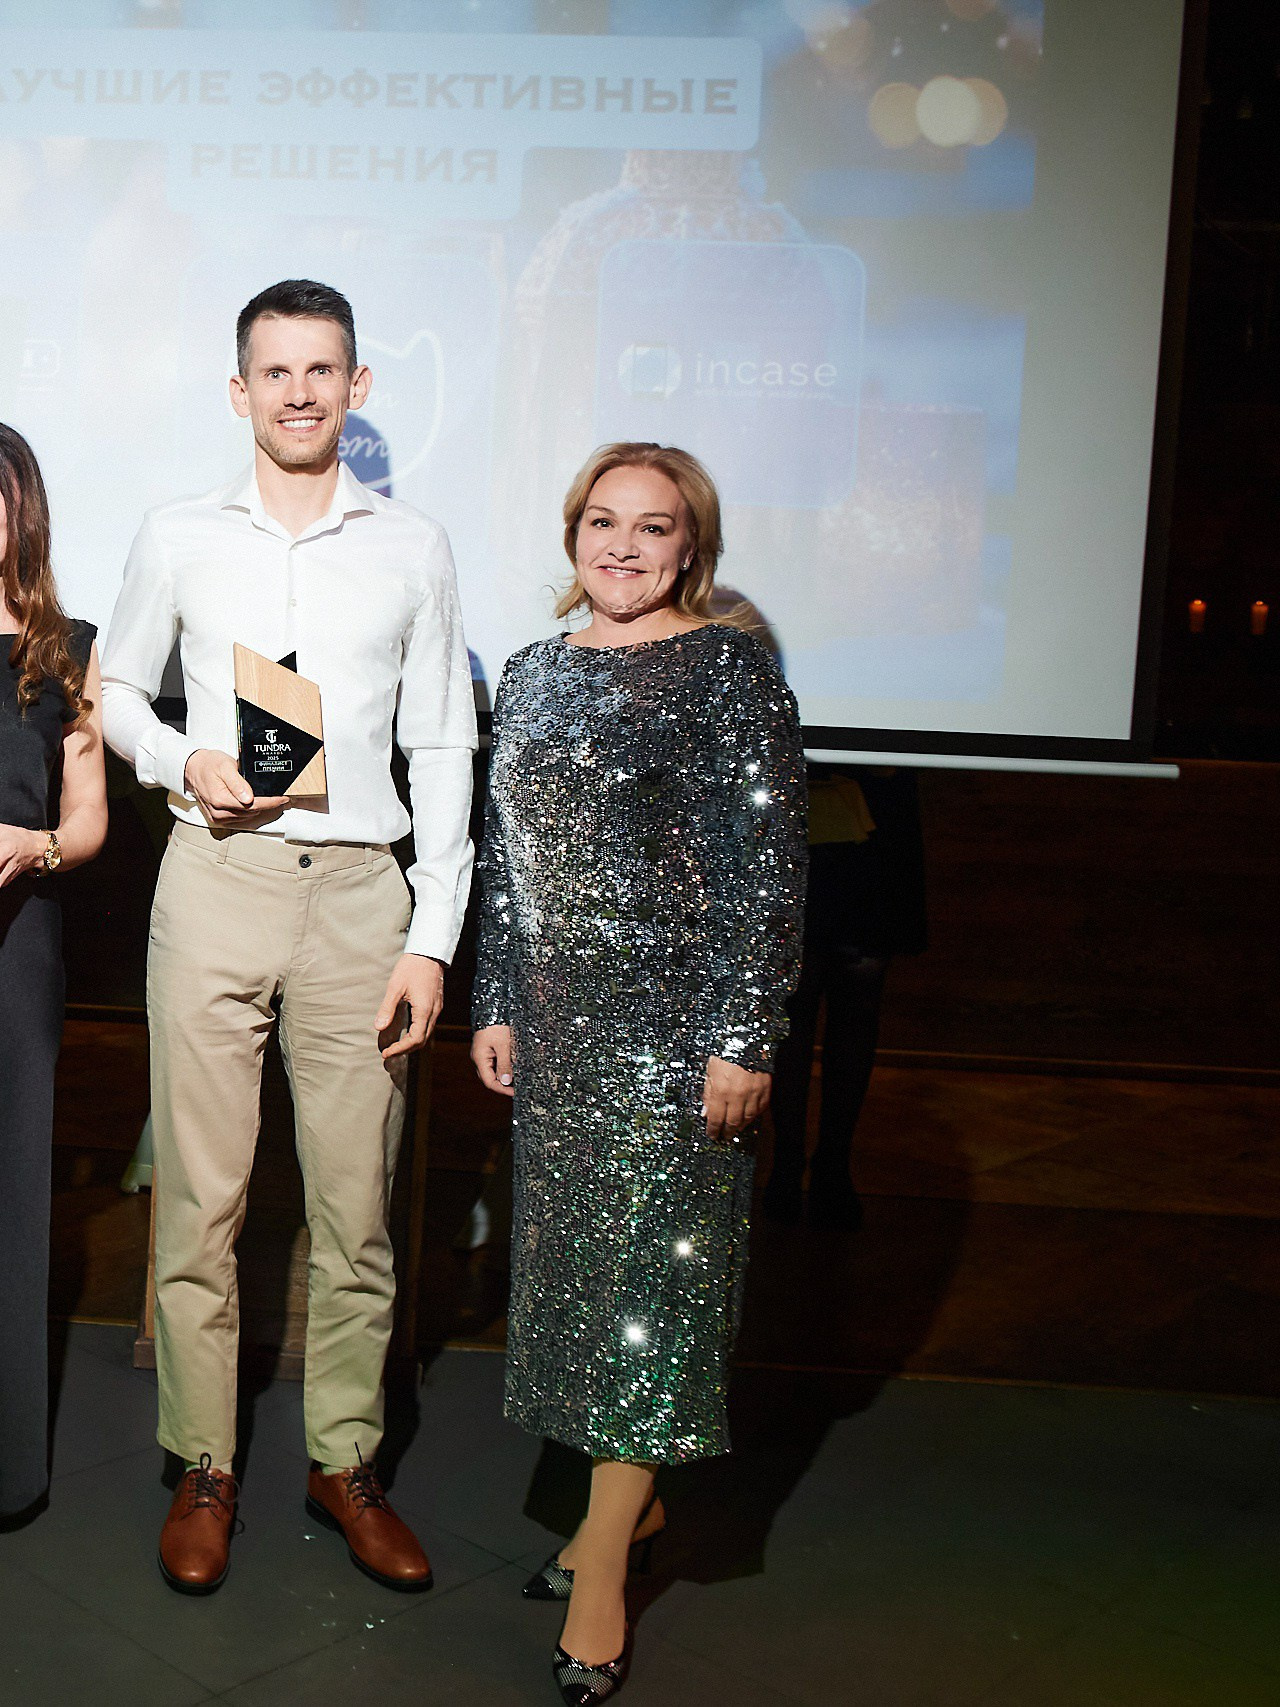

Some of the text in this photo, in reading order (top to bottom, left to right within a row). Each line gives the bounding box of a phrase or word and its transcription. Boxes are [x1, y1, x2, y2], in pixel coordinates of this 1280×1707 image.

[256, 67, 739, 115] ЭФФЕКТИВНЫЕ
[190, 143, 500, 185] РЕШЕНИЯ
[693, 352, 838, 387] incase
[253, 743, 292, 753] TUNDRA
